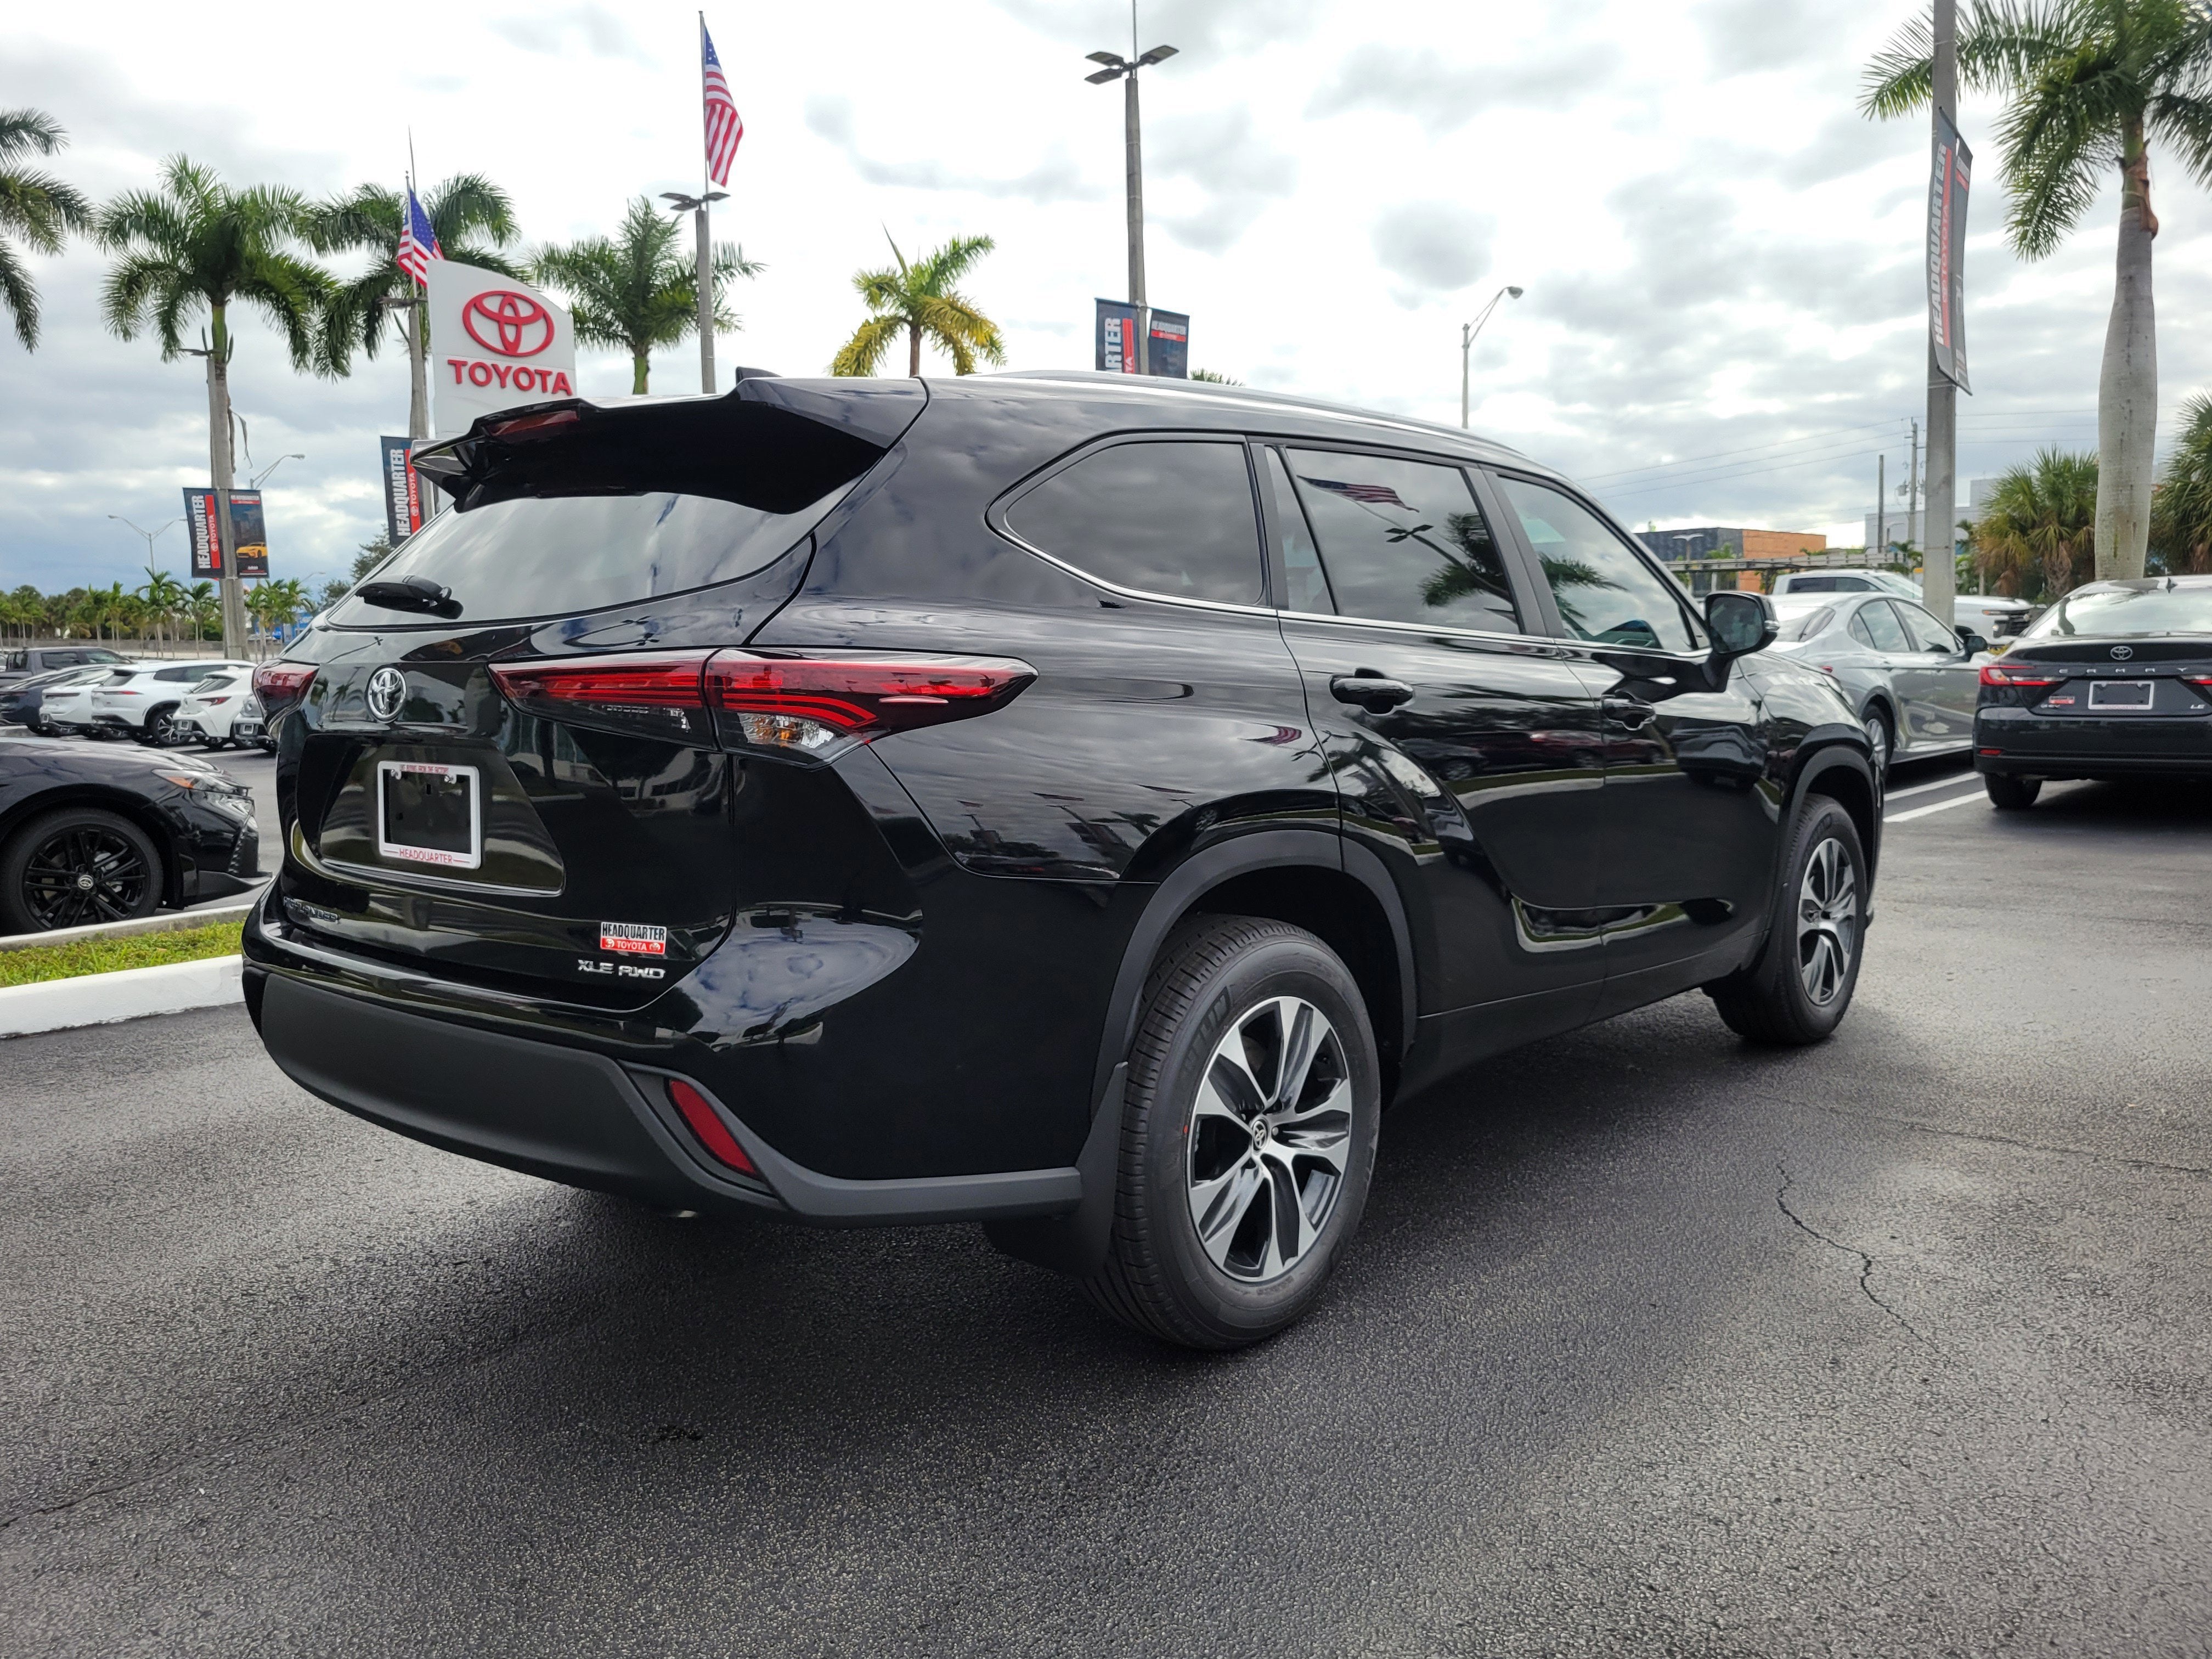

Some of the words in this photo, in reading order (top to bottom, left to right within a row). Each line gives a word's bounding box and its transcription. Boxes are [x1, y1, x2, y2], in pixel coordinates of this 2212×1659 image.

[1931, 142, 1946, 345] HEADQUARTER
[1104, 318, 1122, 373] RTER
[448, 359, 573, 396] TOYOTA
[390, 449, 411, 537] HEADQUARTER
[408, 472, 417, 504] TOYOTA
[192, 495, 211, 569] HEADQUARTER
[208, 515, 217, 542] TOYOTA
[399, 848, 453, 864] HEADQUARTER
[602, 923, 665, 941] HEADQUARTER
[617, 940, 647, 951] TOYOTA
[578, 959, 614, 974] XLE
[618, 966, 666, 979] AWD
